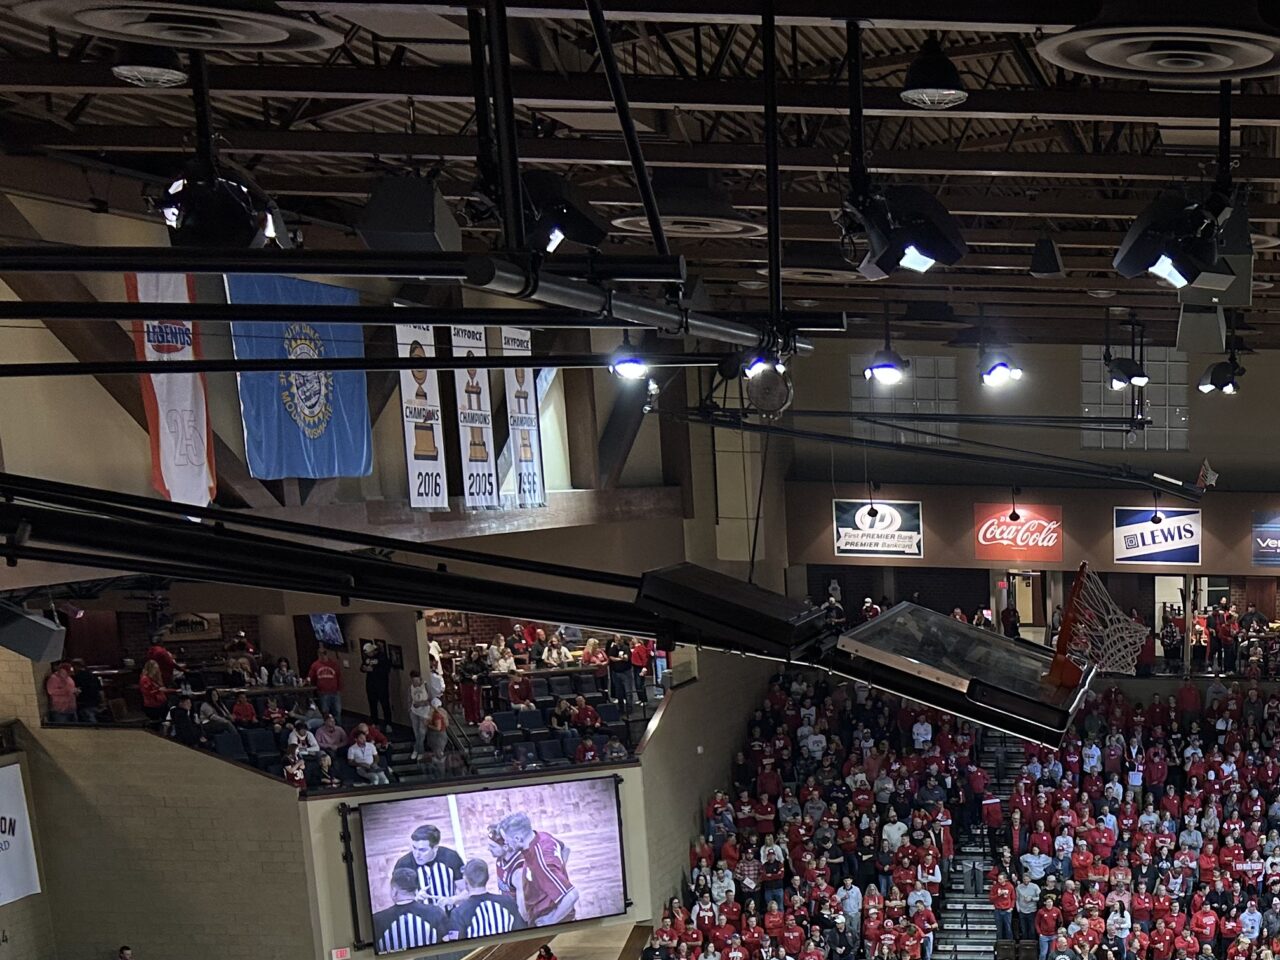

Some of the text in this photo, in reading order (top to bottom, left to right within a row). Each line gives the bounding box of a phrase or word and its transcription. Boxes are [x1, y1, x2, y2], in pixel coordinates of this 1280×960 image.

[146, 323, 193, 347] LEGENDS
[453, 326, 483, 342] SKYFORCE
[503, 336, 530, 350] SKYFORCE
[404, 405, 440, 422] CHAMPIONS
[459, 411, 491, 426] CHAMPIONS
[509, 414, 537, 428] CHAMPIONS
[166, 408, 205, 467] 25
[416, 471, 442, 497] 2016
[468, 472, 494, 497] 2005
[843, 532, 914, 541] First PREMIER Bank
[1140, 523, 1195, 547] LEWIS
[844, 541, 914, 550] PREMIER Bankcard
